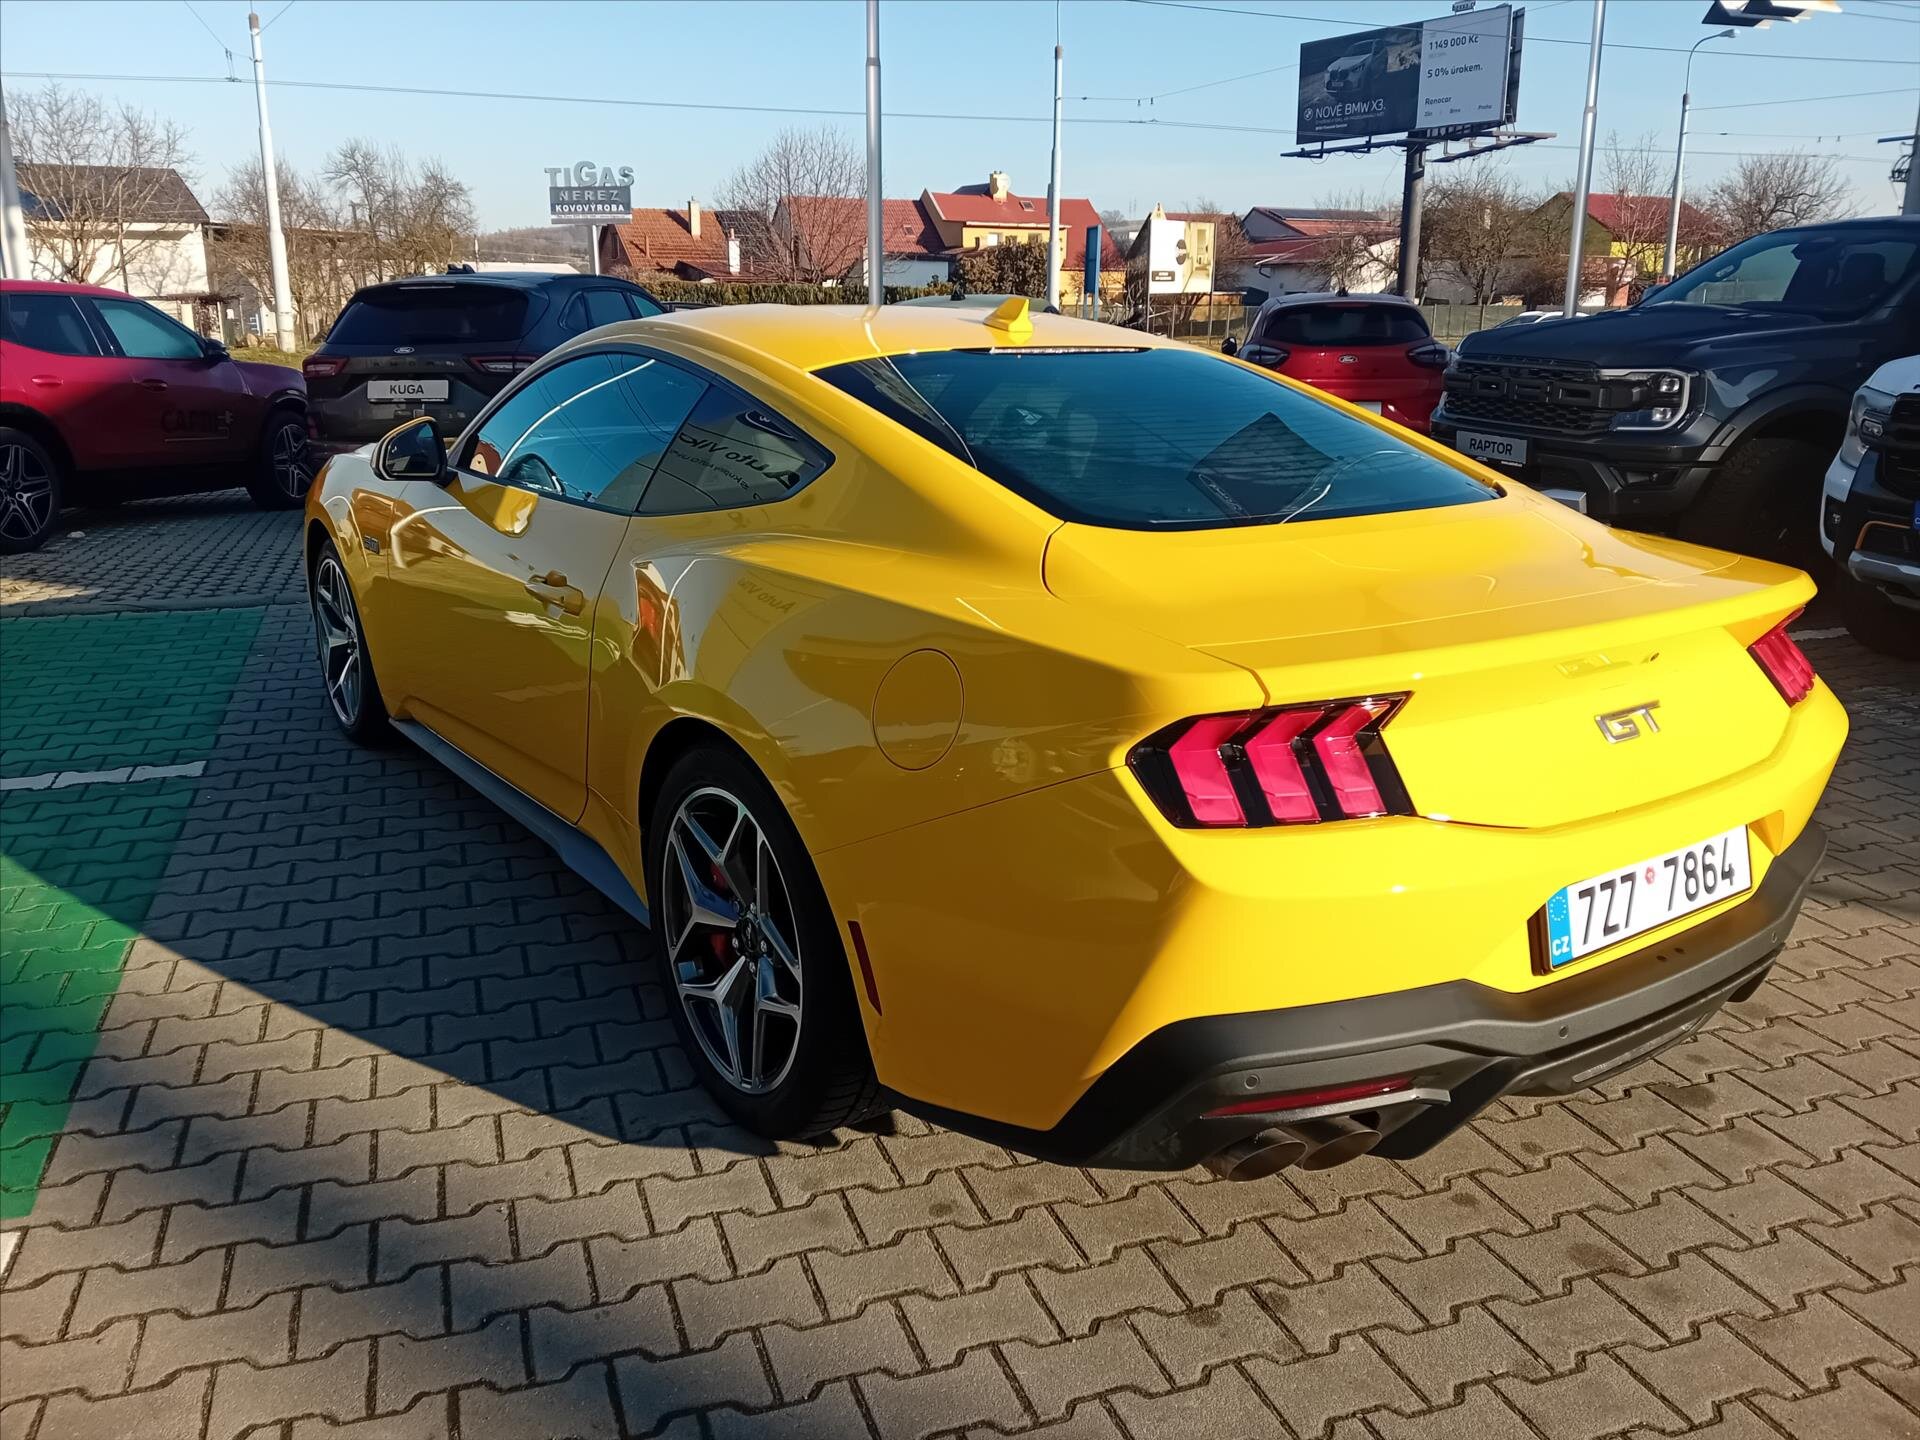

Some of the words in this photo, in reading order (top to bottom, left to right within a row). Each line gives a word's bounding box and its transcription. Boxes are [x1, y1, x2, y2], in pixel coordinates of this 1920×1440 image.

[1450, 36, 1467, 47] 000
[1315, 102, 1343, 118] NOVÉ
[1344, 101, 1370, 115] BMW
[544, 160, 634, 187] TIGAS
[559, 190, 619, 201] NEREZ
[555, 202, 625, 212] KOVOVÝROBA
[389, 384, 424, 395] KUGA
[1469, 438, 1513, 456] RAPTOR
[1593, 699, 1660, 744] GT
[1578, 871, 1637, 945] 7Z7
[1663, 837, 1735, 912] 7864
[1552, 934, 1570, 957] CZ
